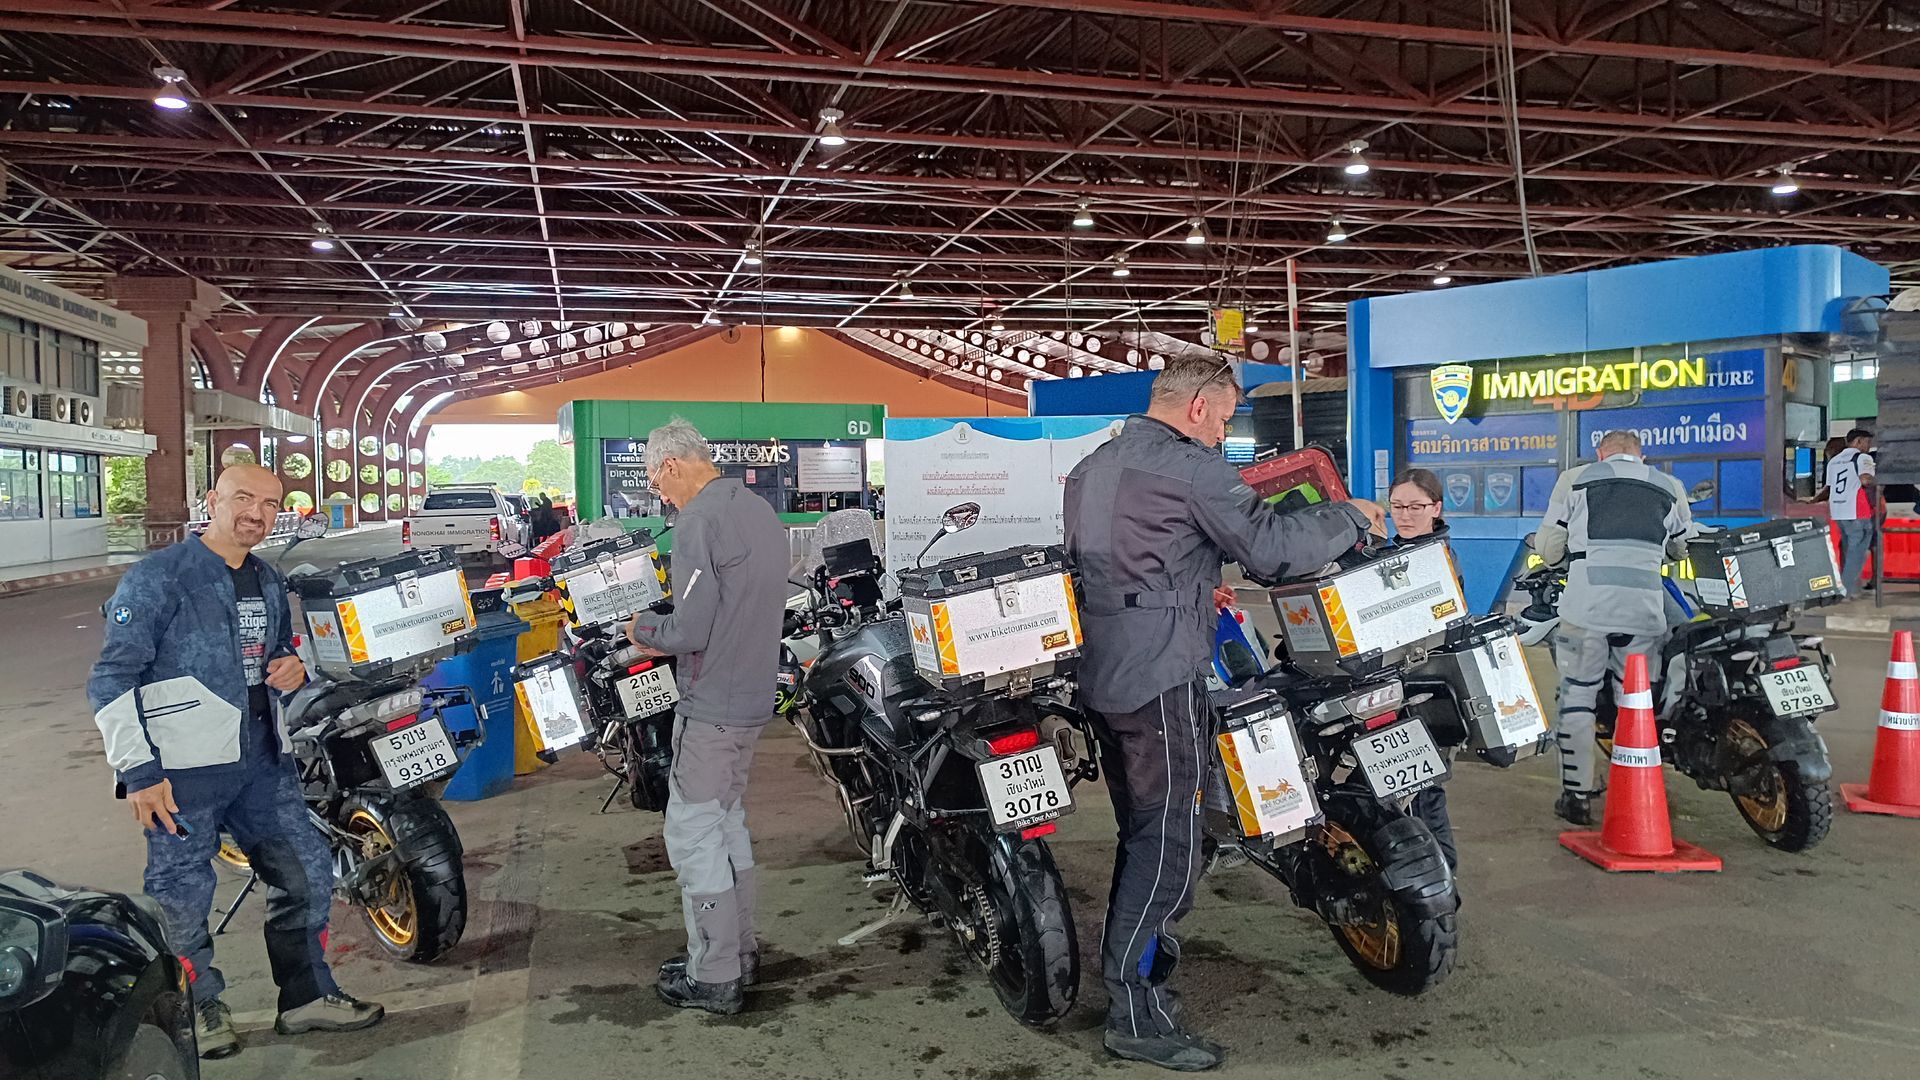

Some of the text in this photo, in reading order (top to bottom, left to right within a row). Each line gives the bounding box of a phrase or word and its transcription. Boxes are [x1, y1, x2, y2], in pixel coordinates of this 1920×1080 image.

[1483, 358, 1705, 400] IMMIGRATION
[847, 420, 871, 435] 6D
[1591, 412, 1747, 447] ตคนเข้าเมือง
[628, 442, 646, 456] ศุล
[710, 444, 790, 463] USTOMS
[1411, 434, 1557, 455] รถบริการสาธารณะ
[610, 470, 647, 478] DIPLOMA
[1835, 469, 1849, 495] 5
[447, 528, 490, 536] IMMIGRATION
[584, 594, 601, 605] BIKE
[627, 581, 646, 592] ASIA
[1361, 585, 1441, 621] www.biketourasia.com
[375, 608, 454, 635] www.biketourasia.com
[968, 614, 1057, 643] www.biketourasia.com
[630, 671, 660, 690] 2กล
[849, 667, 876, 699] 900
[635, 692, 672, 712] 4855
[1781, 693, 1824, 712] 8798
[384, 739, 446, 768] กรุงเทพมหานคร
[1367, 743, 1431, 774] กรุงเทพมหานคร
[399, 753, 447, 781] 9318
[1000, 754, 1043, 779] 3กญ
[1384, 760, 1434, 790] 9274
[1006, 775, 1046, 796] เชียงใหม่
[1408, 784, 1421, 794] Tour
[1421, 779, 1434, 789] Asia
[1004, 790, 1059, 819] 3078
[1016, 809, 1058, 828] Bike Tour Asia
